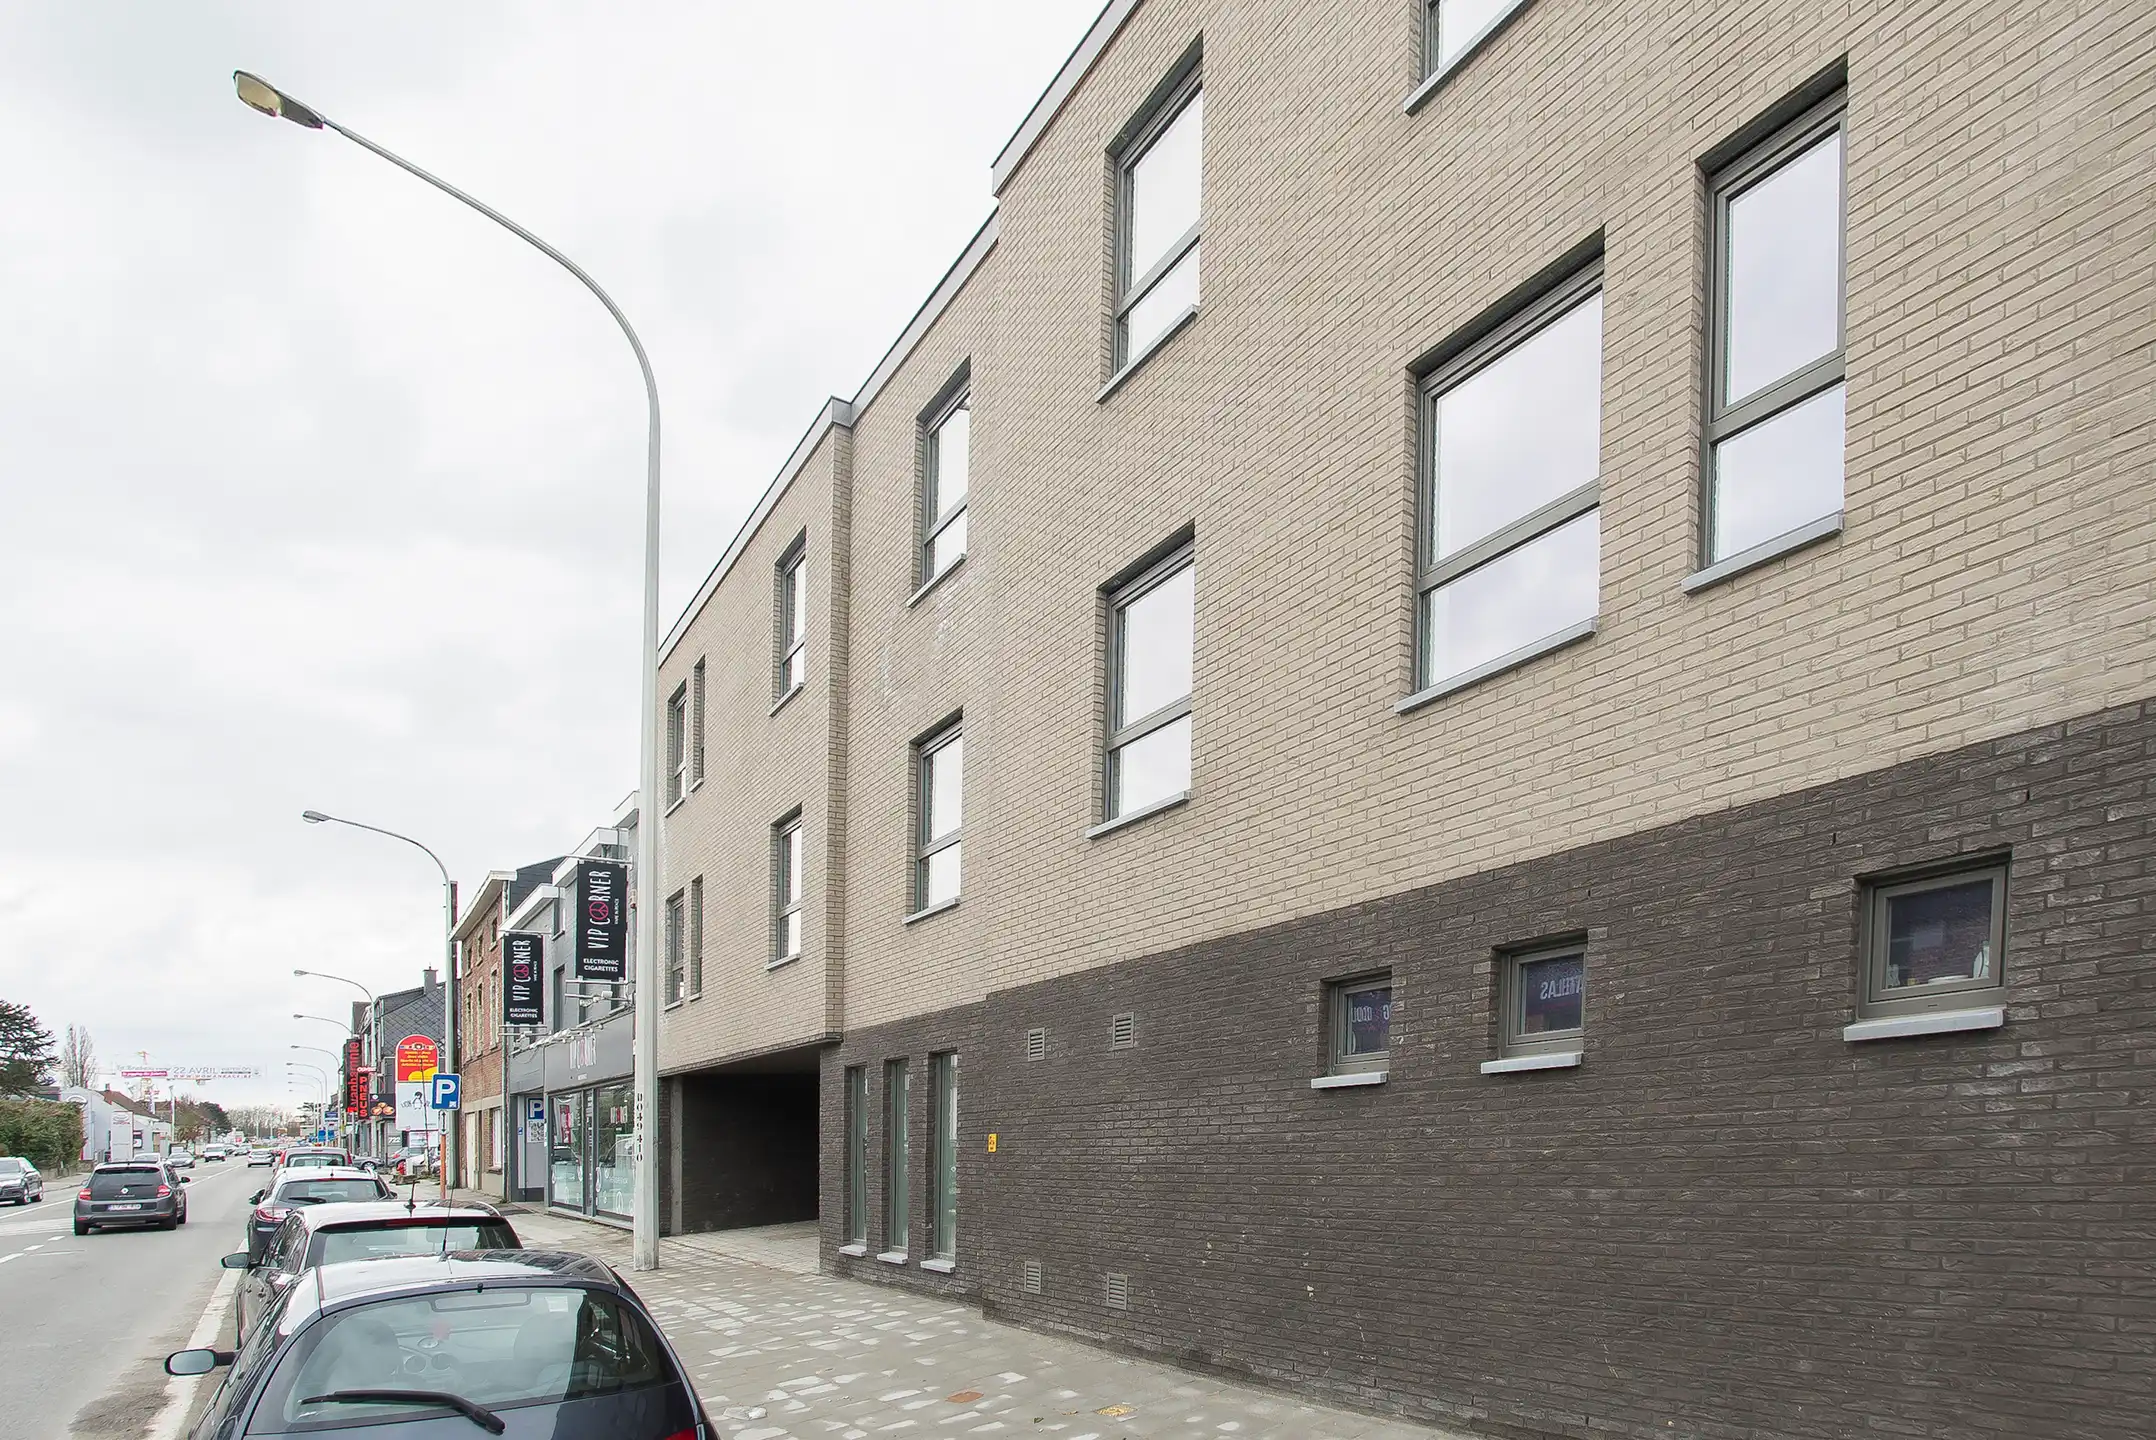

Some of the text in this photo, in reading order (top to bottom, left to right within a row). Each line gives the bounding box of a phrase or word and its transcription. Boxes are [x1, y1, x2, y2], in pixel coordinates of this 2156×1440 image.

[587, 870, 611, 949] VIP CORNER
[512, 939, 531, 1002] VIP CORNER
[583, 958, 620, 966] ELECTRONIC
[173, 1066, 187, 1074] 22
[188, 1066, 217, 1074] AVRIL
[359, 1076, 368, 1117] PNEUS
[436, 1079, 456, 1104] P
[530, 1100, 543, 1118] P
